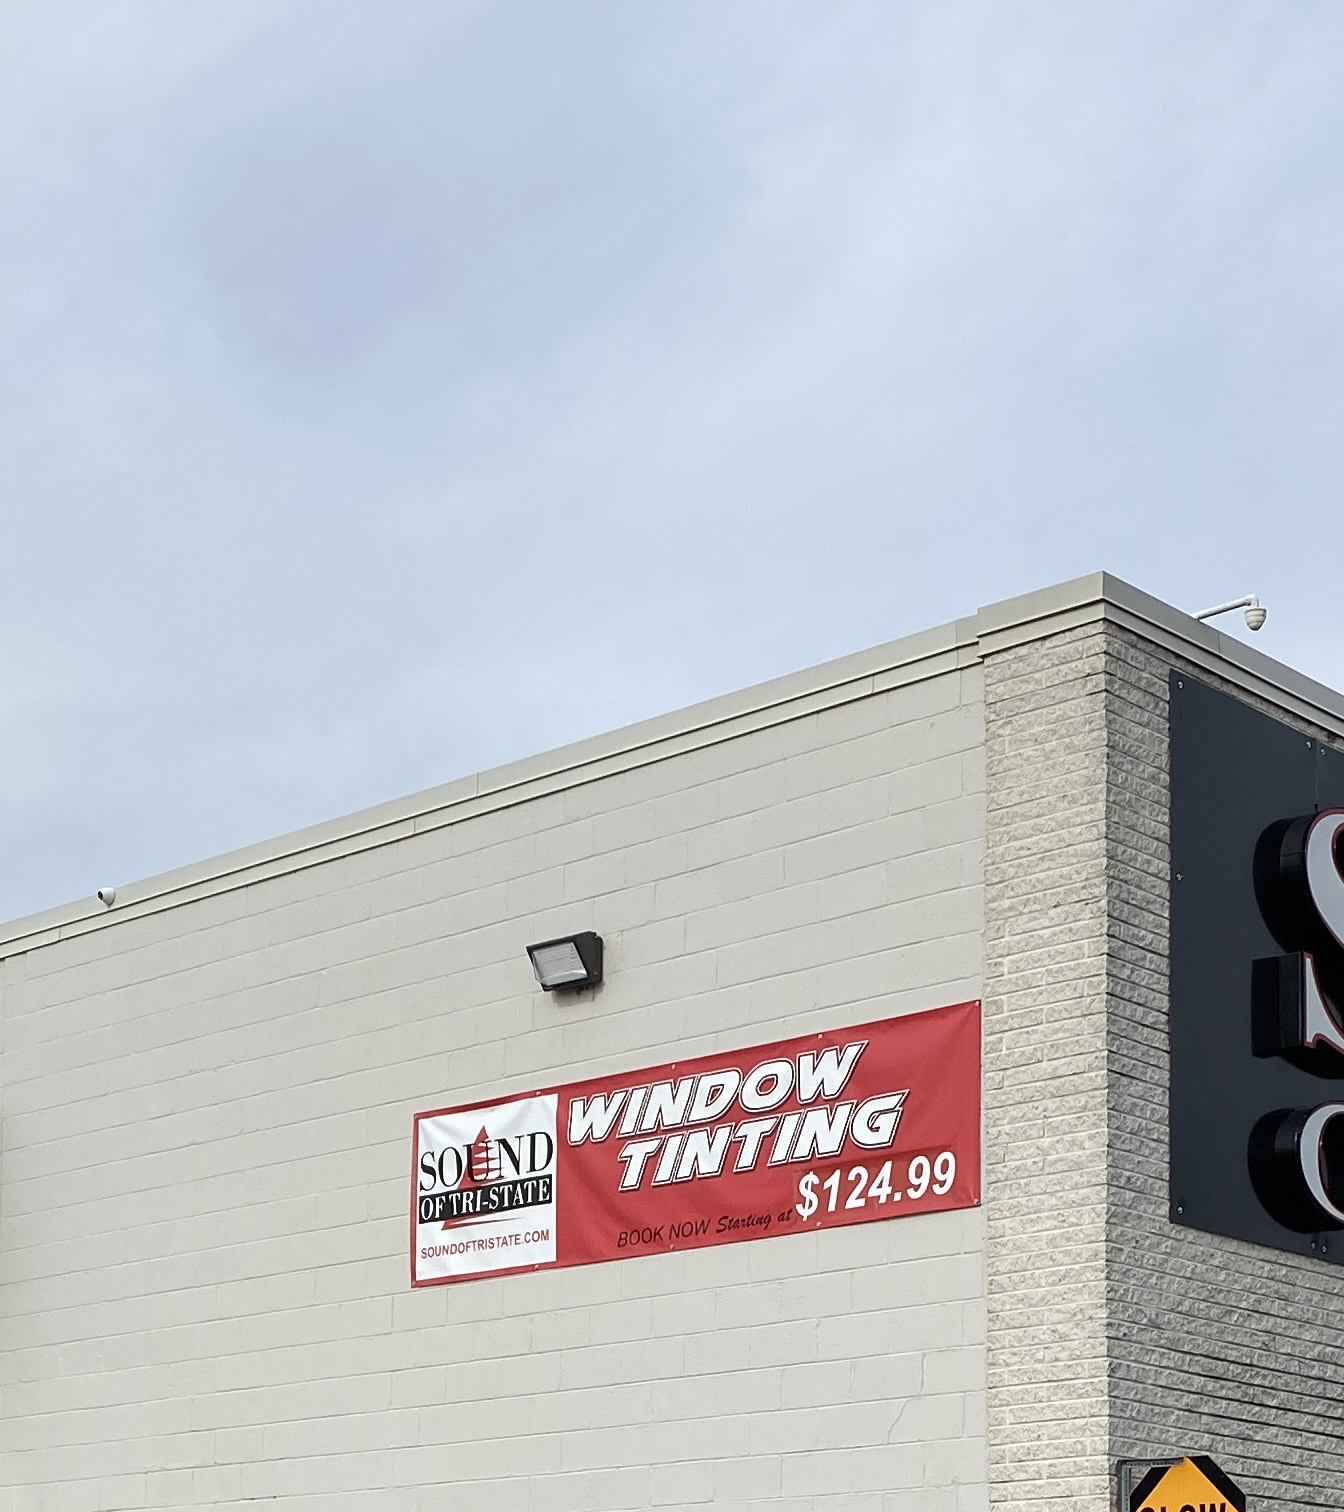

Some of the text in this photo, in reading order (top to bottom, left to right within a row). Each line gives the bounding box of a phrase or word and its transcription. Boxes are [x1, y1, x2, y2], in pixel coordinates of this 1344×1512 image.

[567, 1040, 868, 1146] WINDOW
[420, 1131, 553, 1192] SOUND
[618, 1090, 910, 1191] TINTING
[420, 1178, 550, 1221] OF TRI-STATE
[617, 1151, 955, 1248] BOOK NOW Starting at $124.99
[421, 1229, 549, 1259] SOUNDOFTRISTATE.COM
